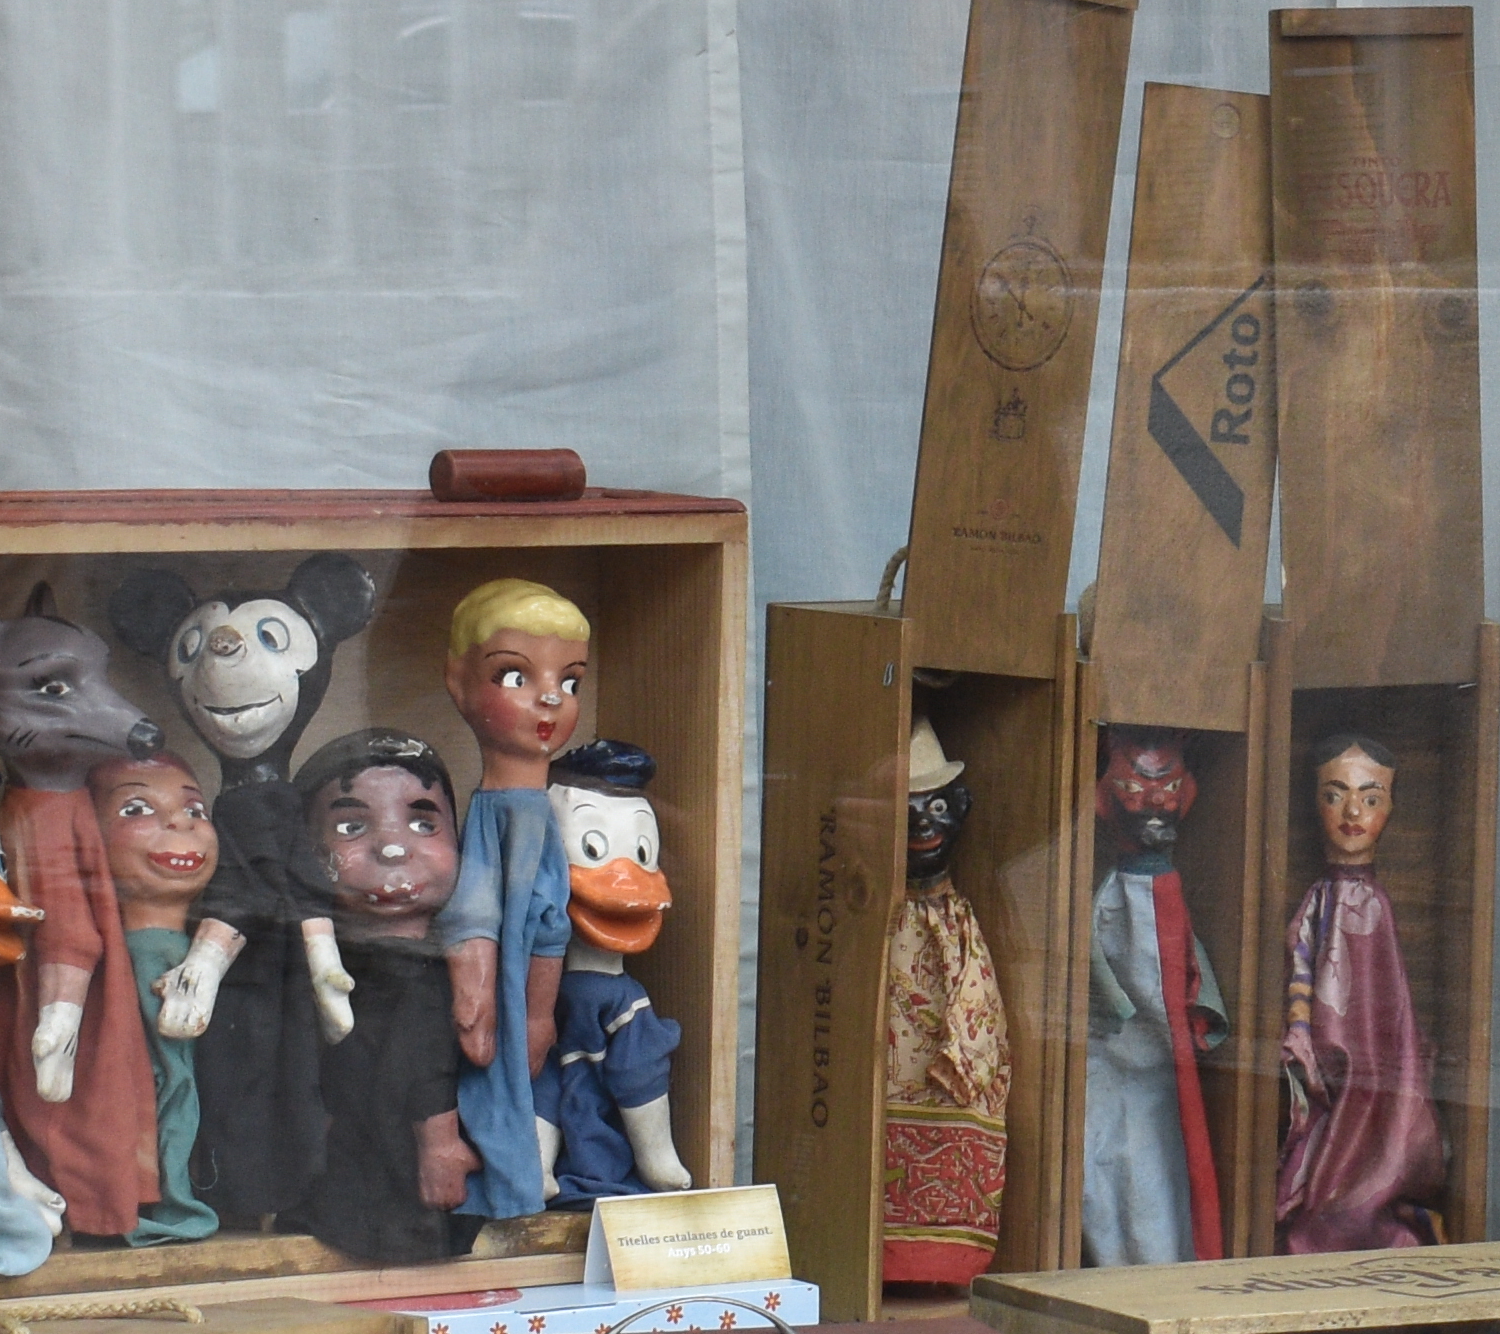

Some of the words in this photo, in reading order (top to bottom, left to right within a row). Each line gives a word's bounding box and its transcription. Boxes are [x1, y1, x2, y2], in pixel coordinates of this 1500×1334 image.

[1209, 311, 1262, 447] Roto
[810, 978, 834, 1130] BILBAO
[617, 1233, 661, 1247] Titelles
[663, 1229, 718, 1244] catalanes
[720, 1227, 735, 1240] de
[736, 1225, 773, 1241] guant.
[667, 1244, 696, 1260] Anys
[697, 1242, 730, 1256] 50-60
[1197, 1267, 1466, 1296] Camps
